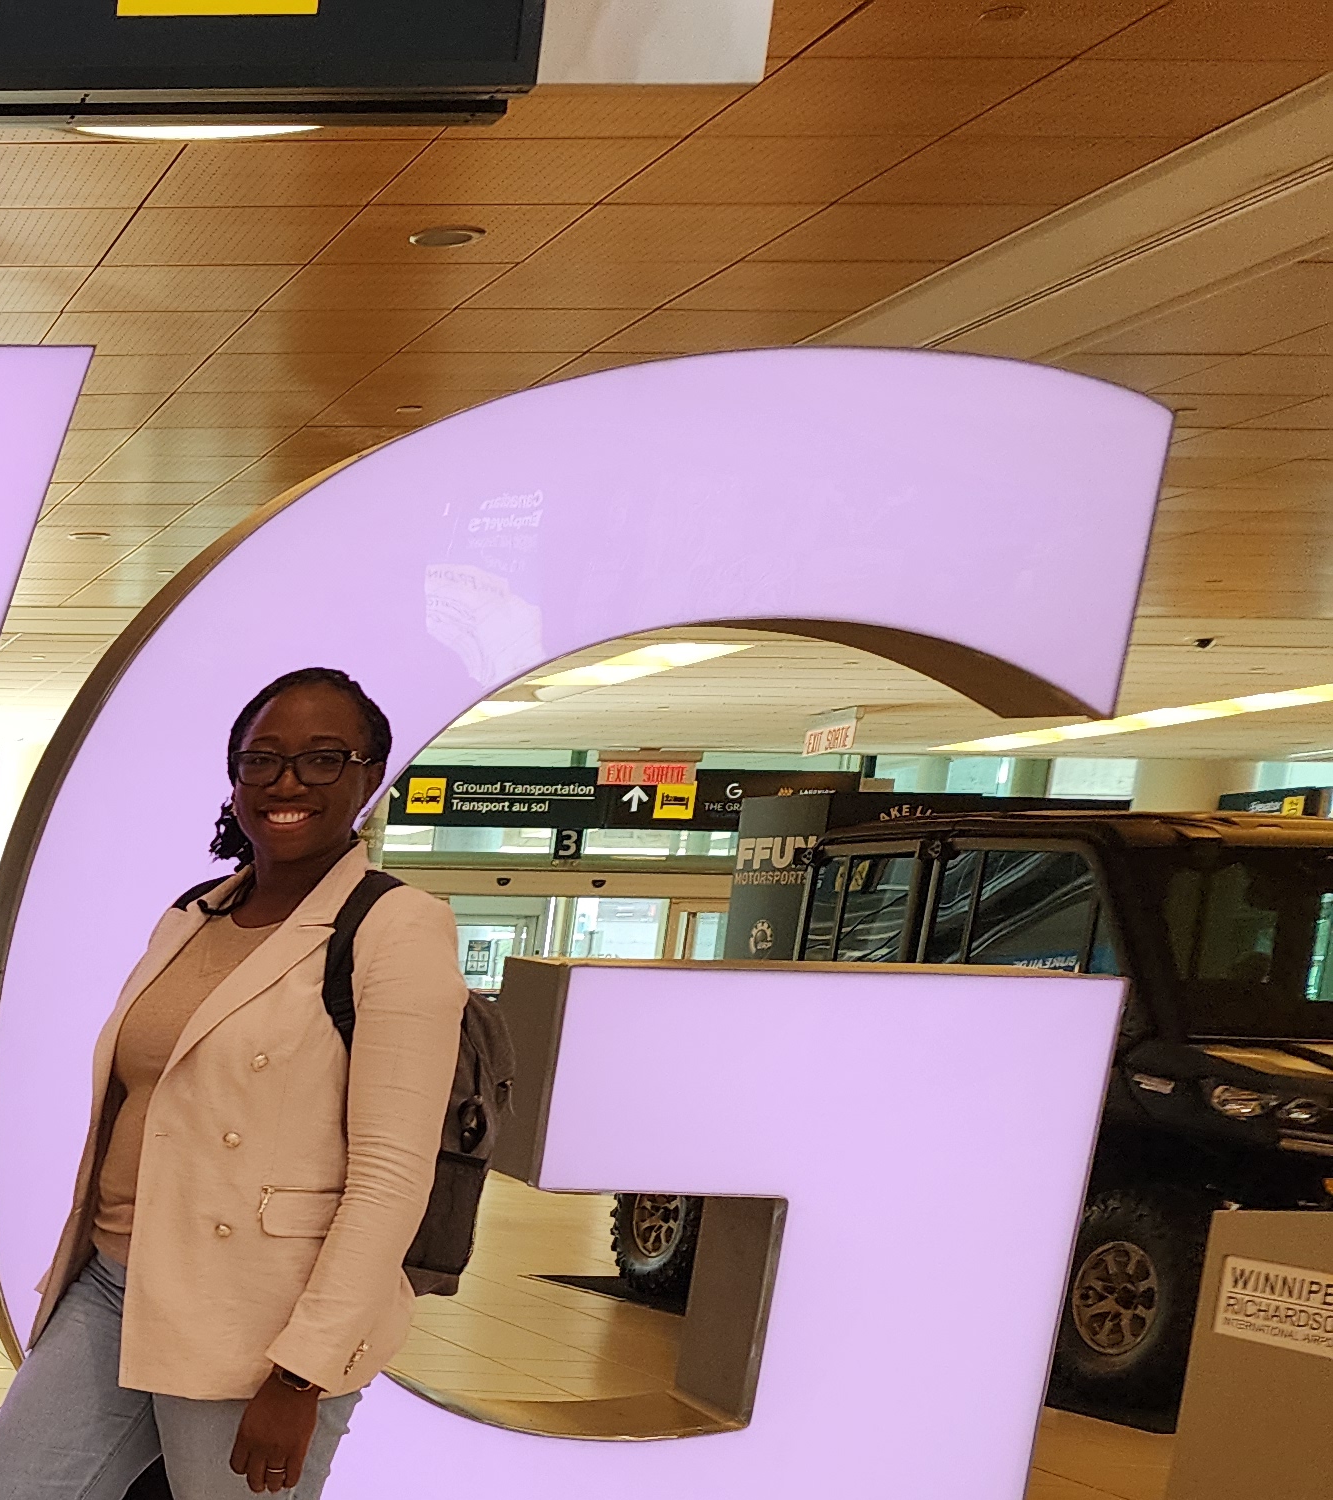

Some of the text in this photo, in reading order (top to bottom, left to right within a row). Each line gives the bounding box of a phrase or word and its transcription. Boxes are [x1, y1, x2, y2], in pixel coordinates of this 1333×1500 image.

[806, 731, 824, 755] EXIT
[606, 764, 688, 785] EXIT SORTIE
[453, 781, 595, 796] Ground Transportation
[451, 799, 549, 813] Transport au sol
[704, 802, 724, 811] THE
[558, 830, 578, 856] 3
[1231, 1267, 1333, 1306] WINNIPE
